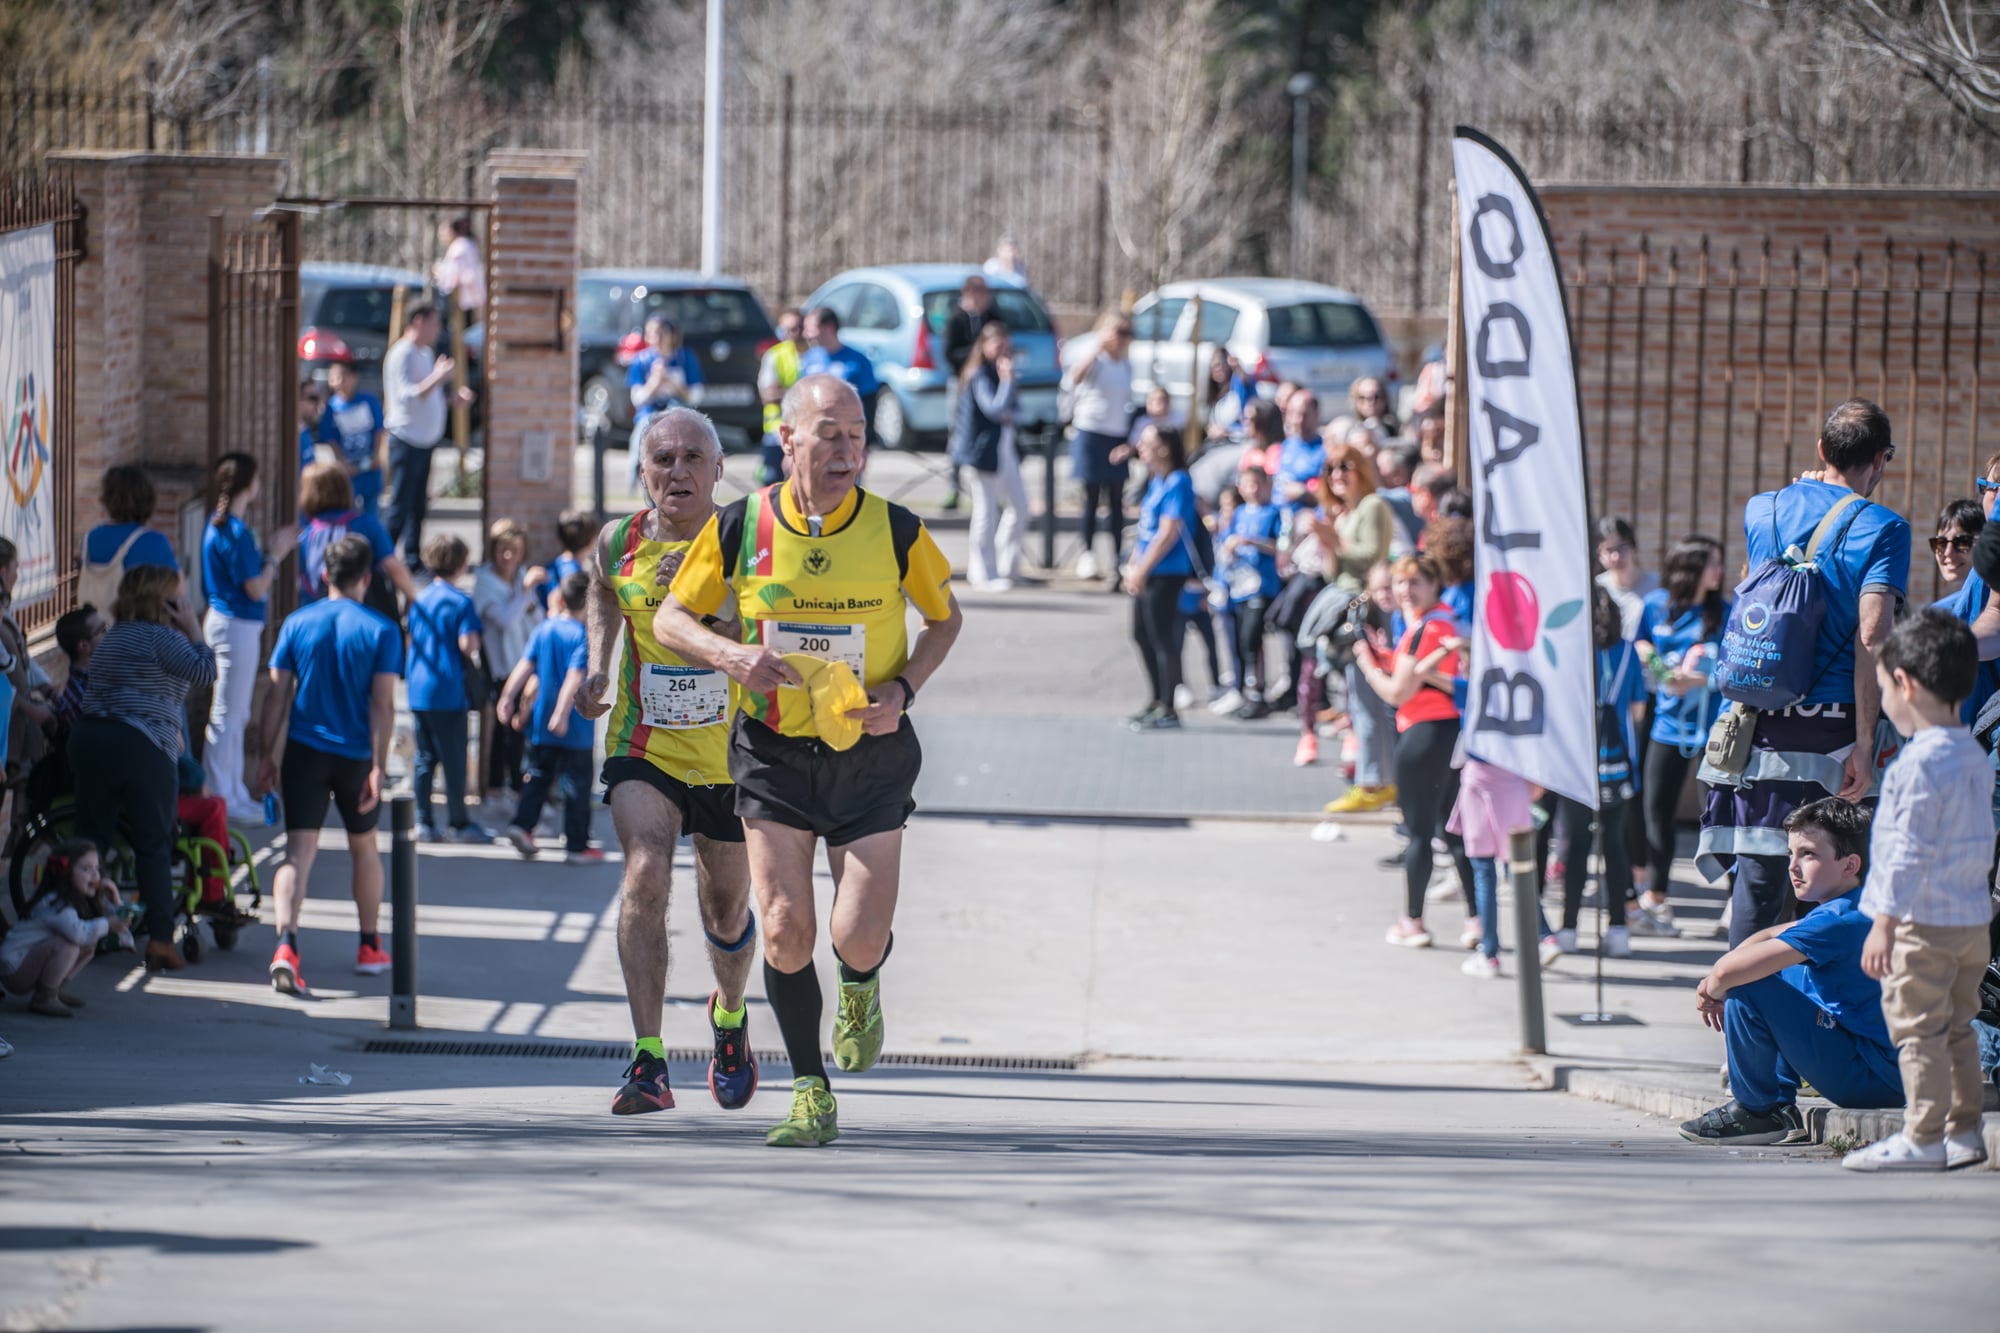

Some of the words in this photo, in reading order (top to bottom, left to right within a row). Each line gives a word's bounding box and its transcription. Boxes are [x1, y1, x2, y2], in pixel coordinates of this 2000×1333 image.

[793, 597, 845, 613] Unicaja
[848, 598, 883, 609] Banco
[799, 637, 830, 652] 200
[1767, 652, 1782, 661] en
[669, 678, 697, 692] 264
